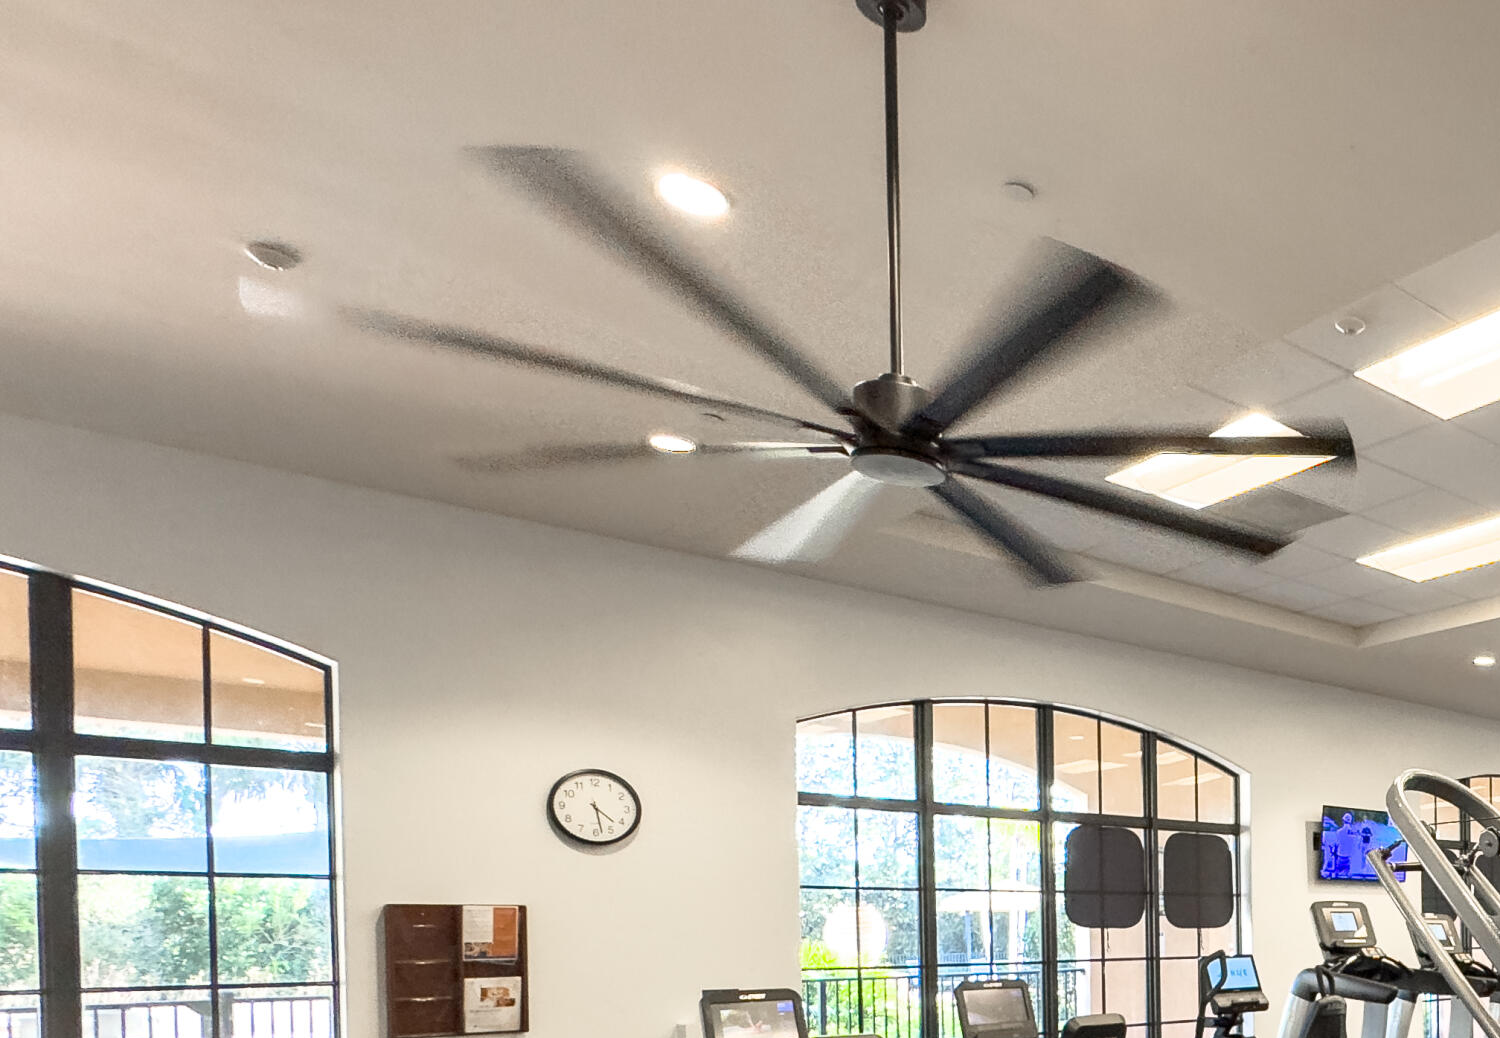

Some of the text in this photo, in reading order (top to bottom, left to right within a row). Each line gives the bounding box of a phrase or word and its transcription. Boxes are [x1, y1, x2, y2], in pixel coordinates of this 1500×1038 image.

[574, 782, 583, 790] 11
[590, 778, 600, 787] 12
[608, 784, 612, 792] 1
[564, 789, 575, 798] 10
[618, 792, 625, 800] 2
[559, 801, 565, 809] 9
[624, 805, 630, 813] 3
[565, 814, 572, 823] 8
[578, 824, 584, 832] 7
[608, 826, 614, 834] 5
[592, 828, 599, 837] 6
